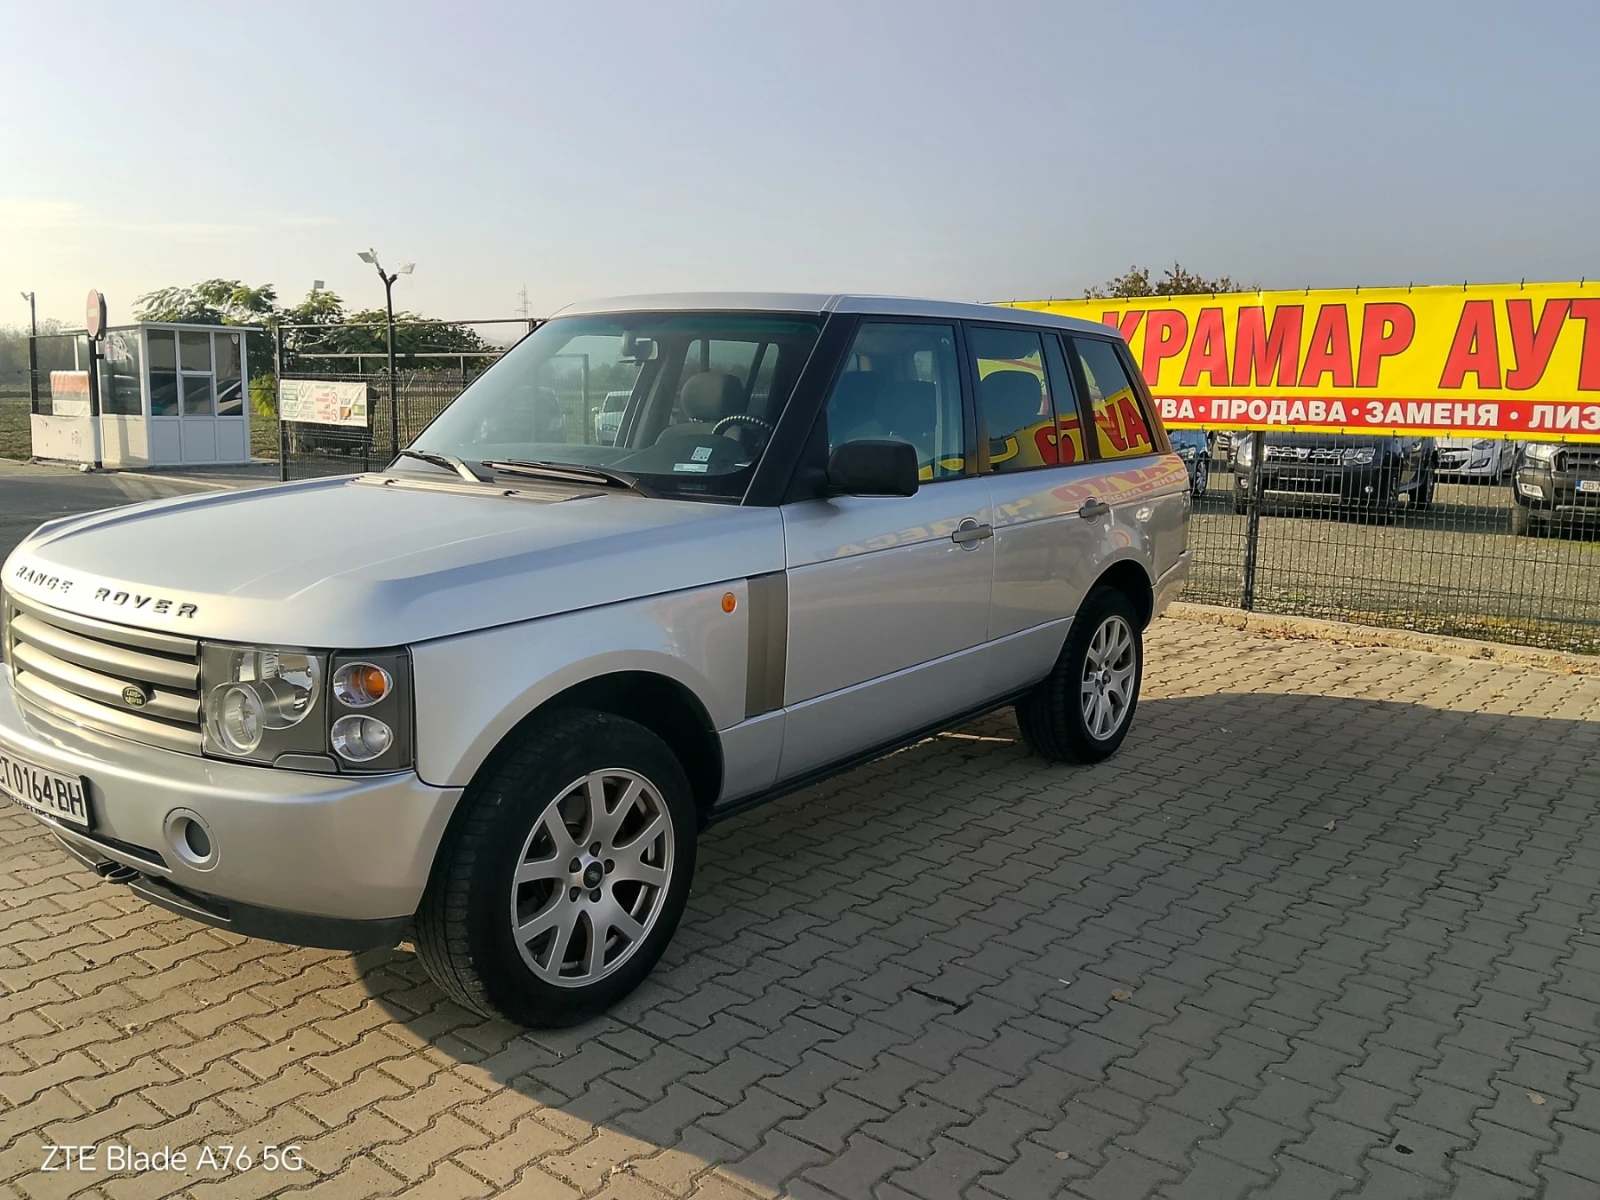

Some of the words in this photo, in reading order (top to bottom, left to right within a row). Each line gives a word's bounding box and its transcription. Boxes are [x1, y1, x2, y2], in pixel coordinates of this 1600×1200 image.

[1437, 298, 1600, 391] АУТ
[1210, 400, 1348, 425] ПРОДАВА
[1364, 401, 1499, 427] ЗАМЕНЯ
[1528, 404, 1600, 431] ЛИЗ
[15, 565, 74, 594] RANGE
[94, 587, 200, 619] ROVER
